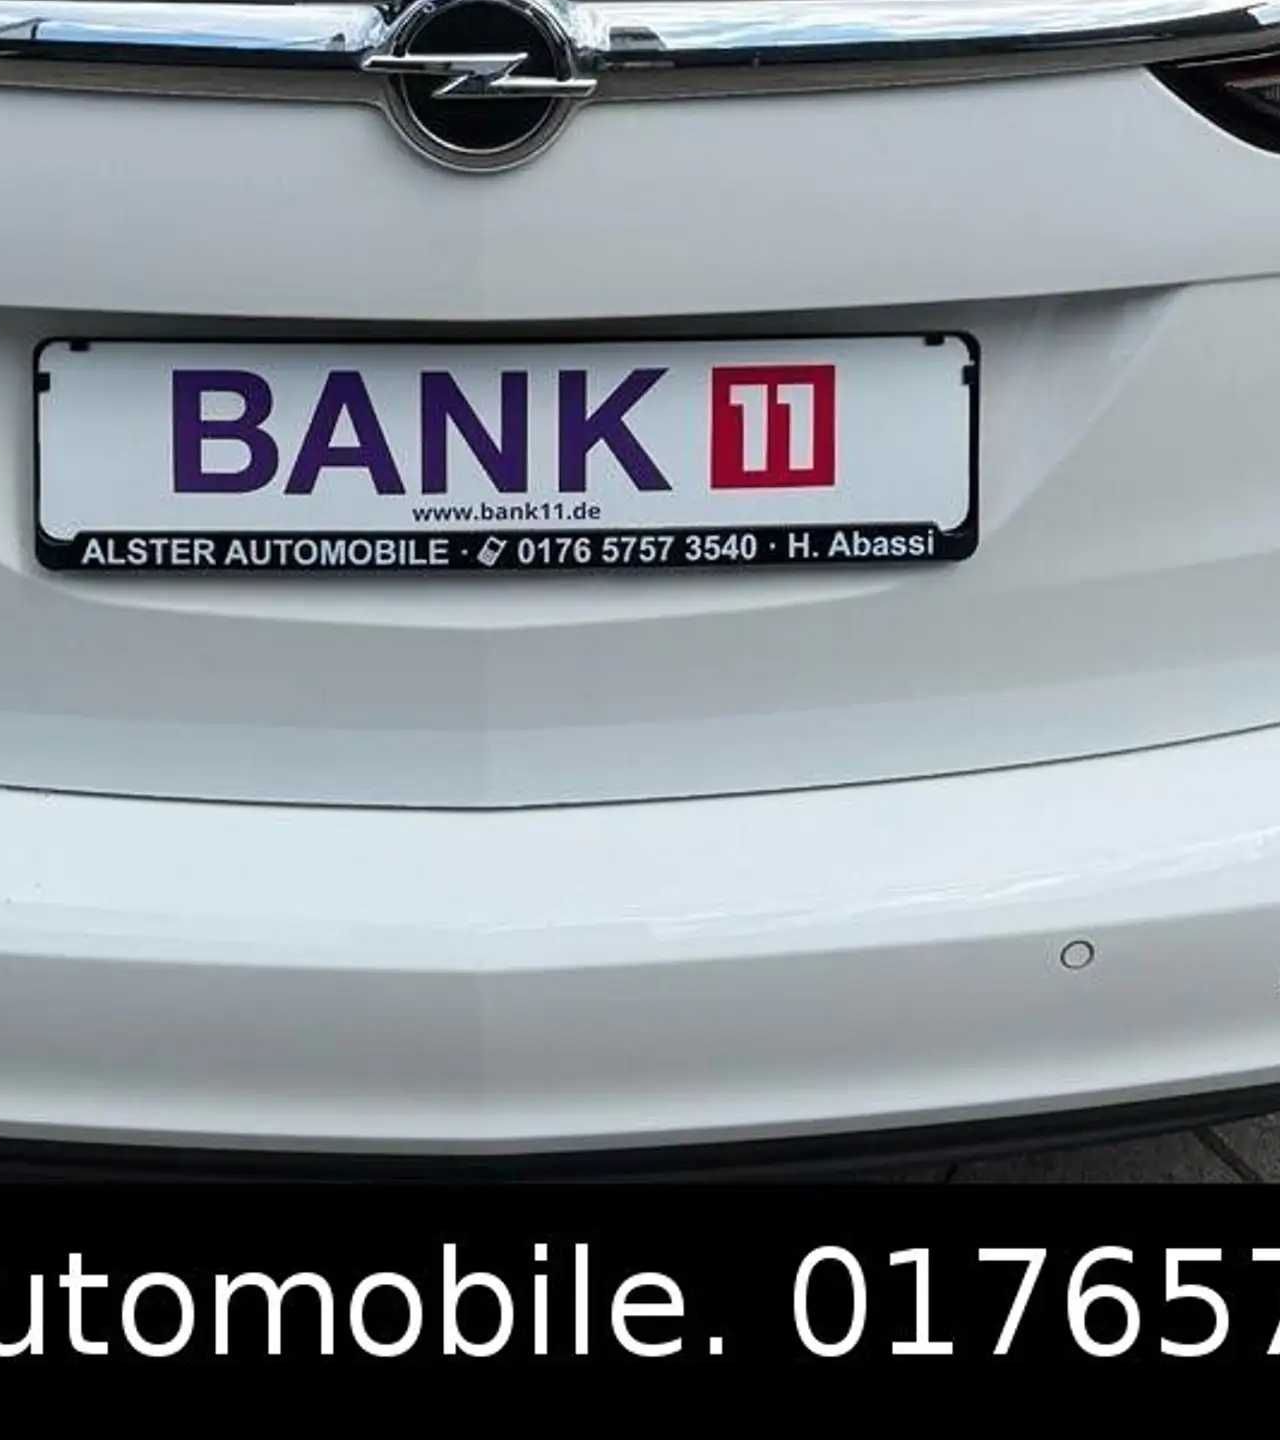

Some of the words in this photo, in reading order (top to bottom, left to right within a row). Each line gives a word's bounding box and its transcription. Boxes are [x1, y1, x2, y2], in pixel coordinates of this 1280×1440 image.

[172, 367, 673, 496] BANK
[728, 382, 815, 472] 11
[411, 500, 602, 522] www.bank11.de
[81, 537, 216, 565] ALSTER
[224, 537, 450, 566] AUTOMOBILE
[517, 537, 592, 564] 0176
[601, 535, 674, 562] 5757
[684, 533, 757, 561] 3540
[787, 532, 819, 559] H.
[828, 529, 936, 558] Abassi
